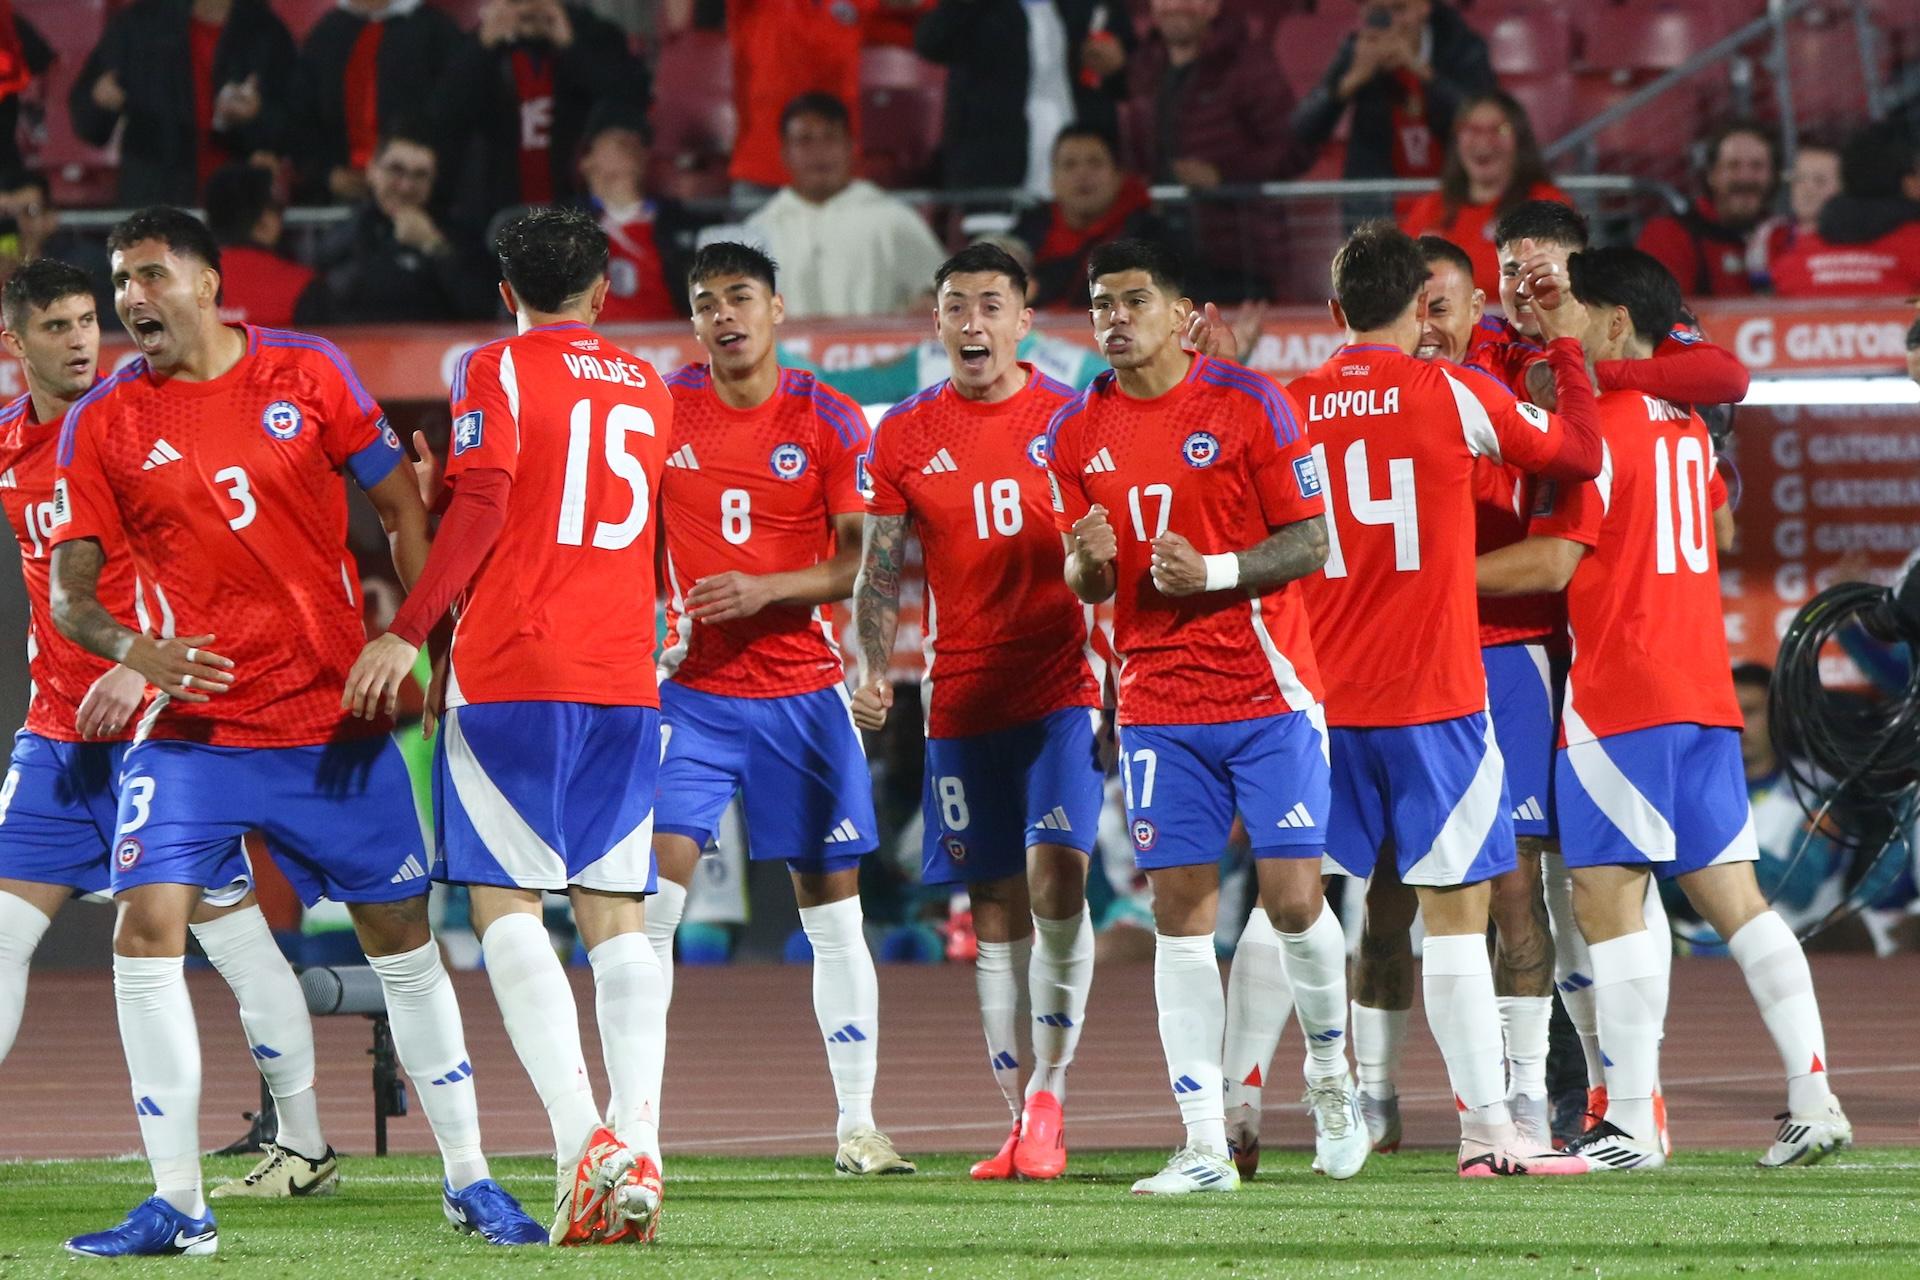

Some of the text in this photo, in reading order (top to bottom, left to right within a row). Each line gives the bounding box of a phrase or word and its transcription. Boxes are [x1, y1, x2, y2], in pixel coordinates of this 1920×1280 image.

[562, 353, 647, 389] VALDÉS
[1736, 319, 1908, 367] G GATOR
[1309, 386, 1400, 422] LOYOLA
[214, 466, 257, 531] 3
[557, 398, 656, 550] 15
[720, 488, 751, 545] 8
[973, 478, 1023, 540] 18
[1128, 483, 1173, 542] 17
[1311, 438, 1421, 579] 14
[1655, 436, 1709, 574] 10
[119, 776, 156, 835] 3
[1123, 748, 1157, 810] 17
